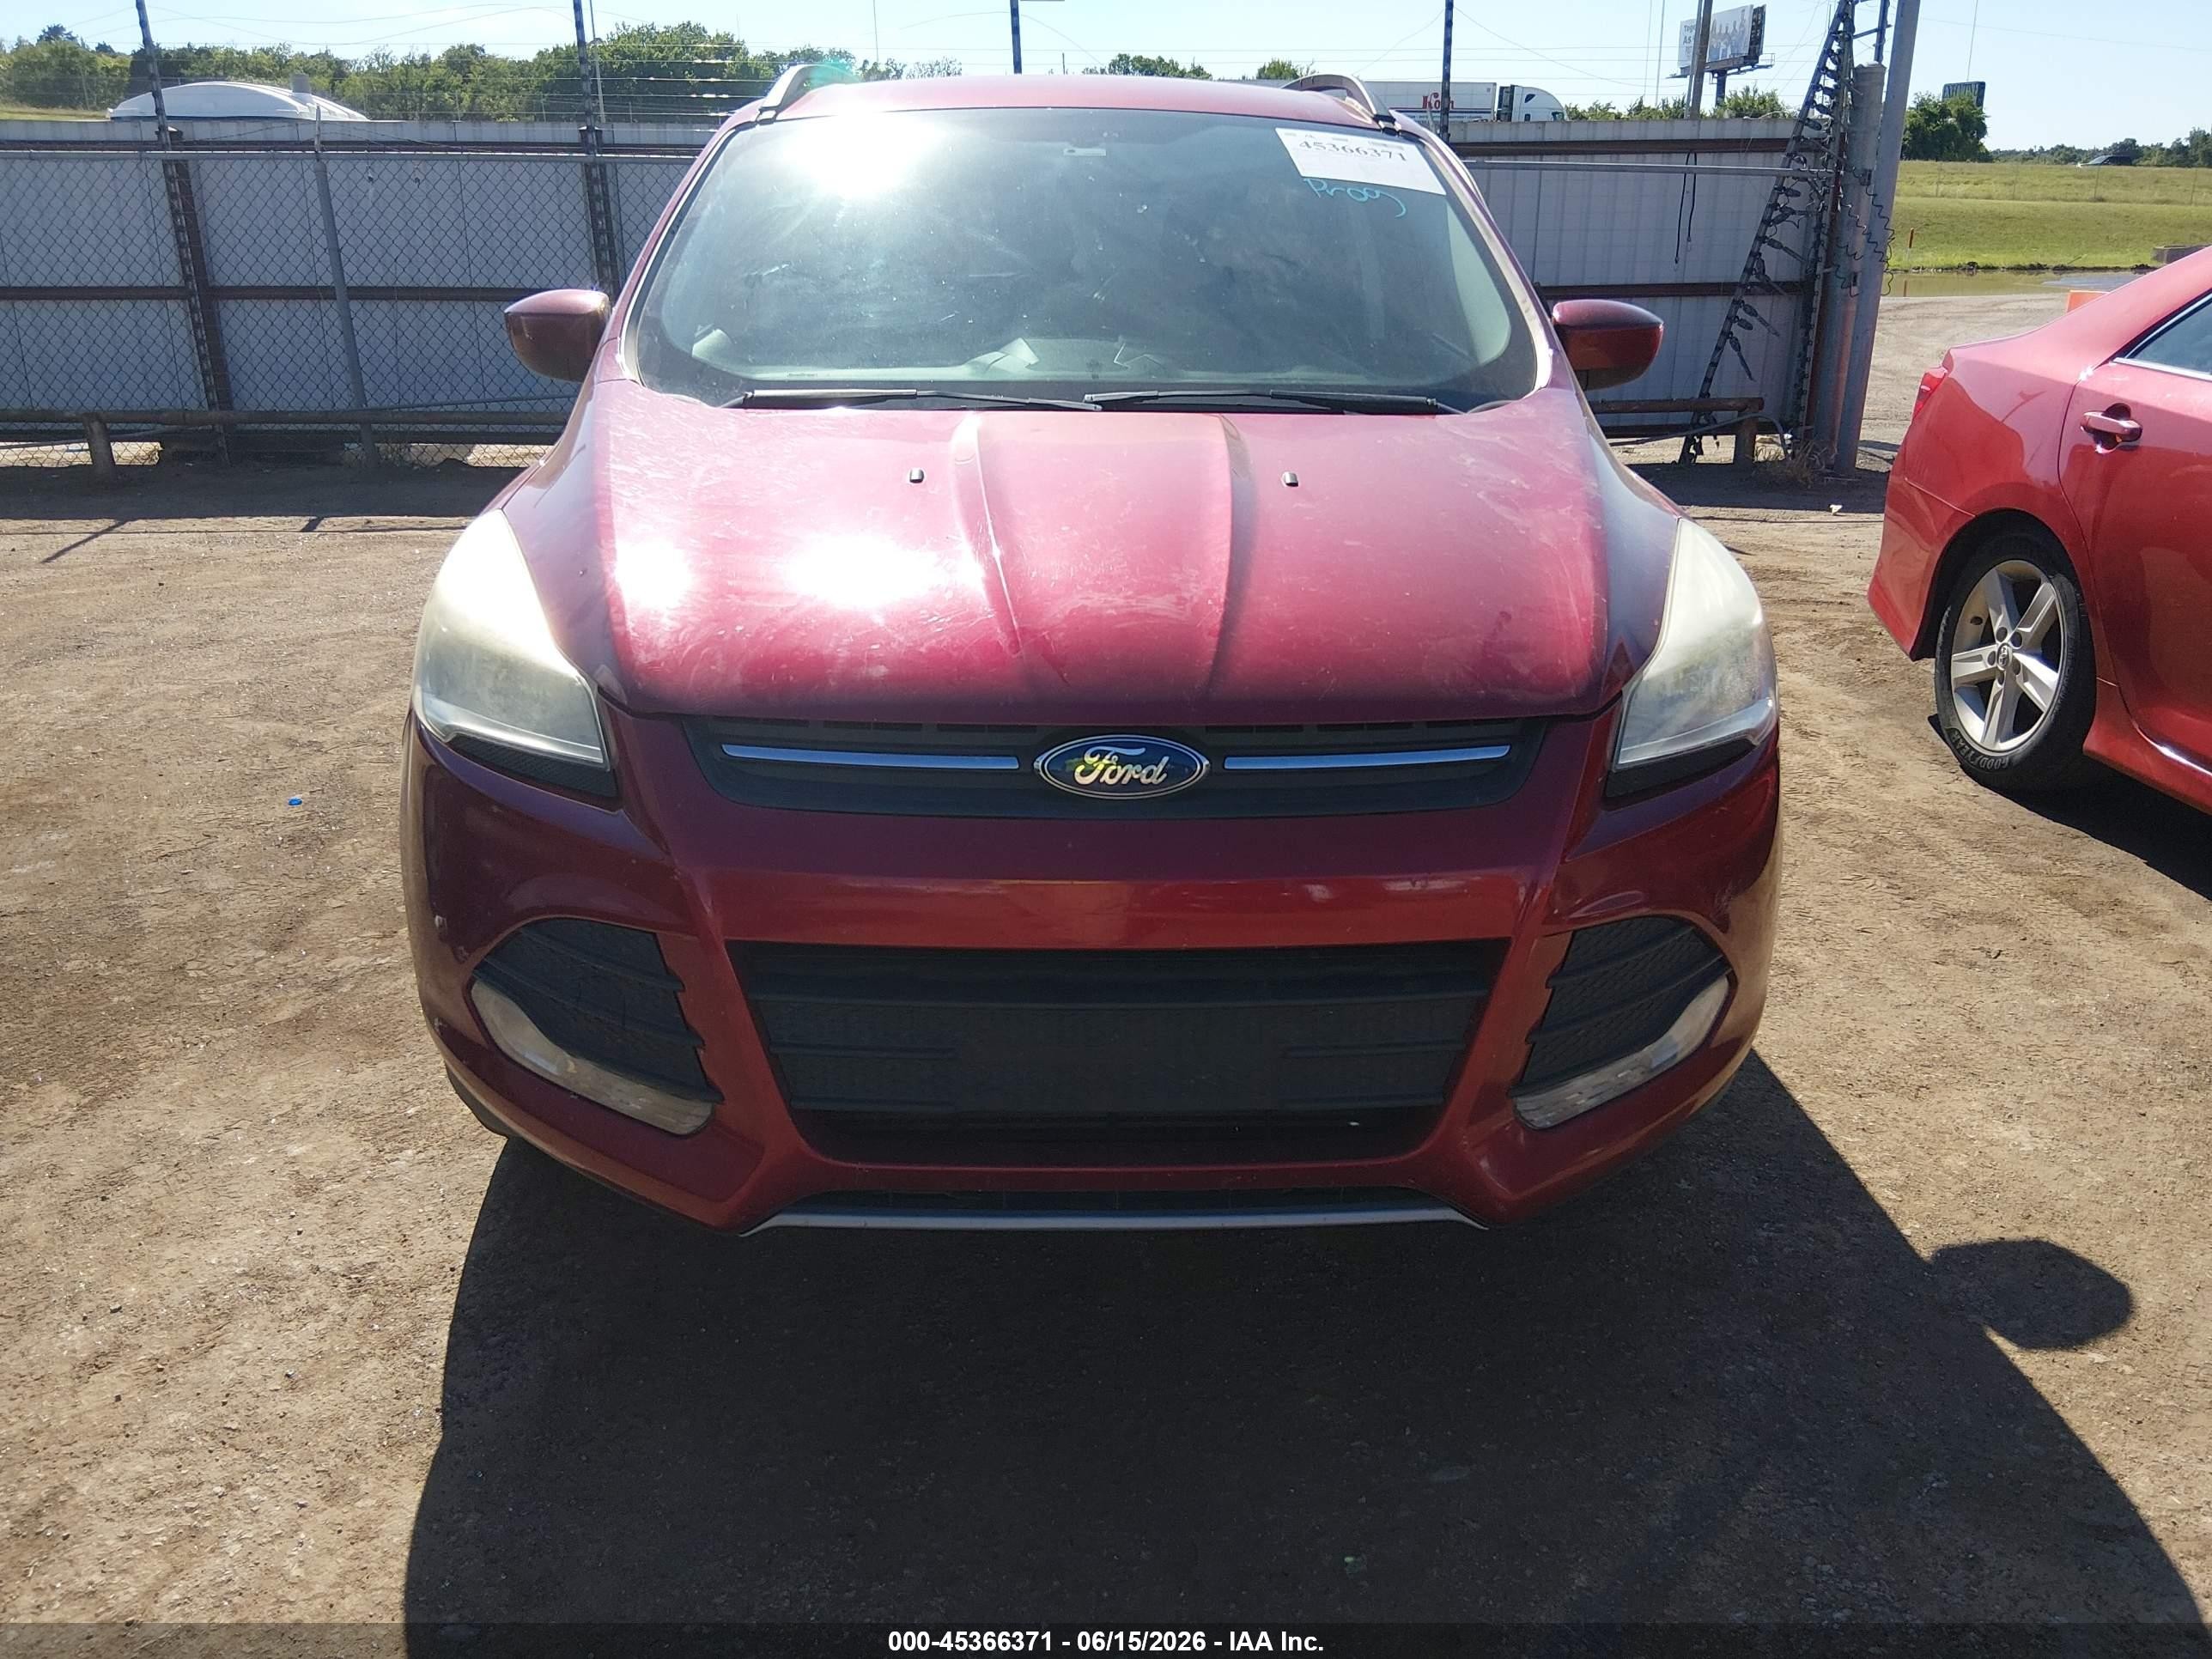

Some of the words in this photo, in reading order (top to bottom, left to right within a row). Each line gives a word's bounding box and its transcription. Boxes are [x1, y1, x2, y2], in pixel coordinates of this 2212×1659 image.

[1299, 141, 1407, 161] 45366371
[1073, 745, 1170, 786] Ford
[1950, 730, 2009, 769] GOODYEAR
